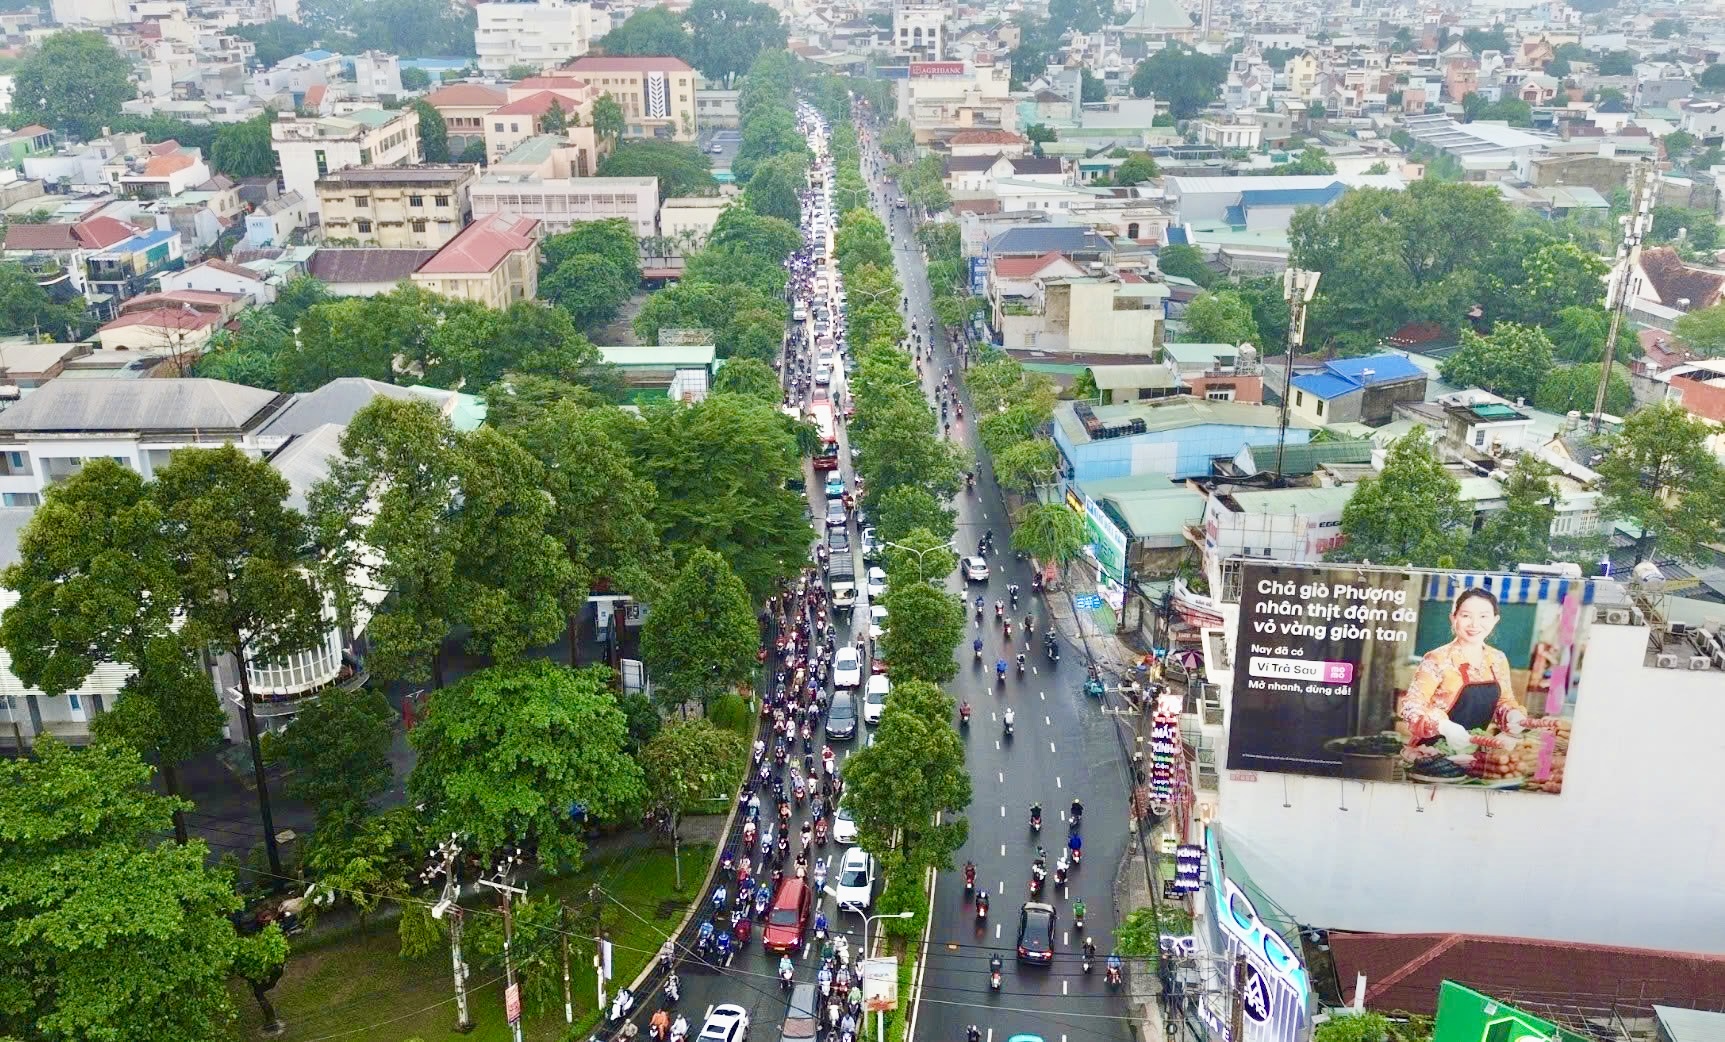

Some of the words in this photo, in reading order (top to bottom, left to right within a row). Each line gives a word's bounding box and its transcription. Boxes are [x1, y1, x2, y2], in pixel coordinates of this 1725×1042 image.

[1257, 579, 1296, 597] Chả
[1299, 582, 1330, 600] giò
[1333, 584, 1407, 605] Phượng
[1255, 600, 1303, 616] nhân
[1307, 602, 1341, 621] thịt
[1344, 605, 1388, 623] đậm
[1391, 607, 1417, 623] đà
[1253, 619, 1277, 634] vỏ
[1280, 620, 1327, 640] vàng
[1330, 623, 1372, 641] giòn
[1375, 627, 1408, 642] tan
[1251, 644, 1272, 656] Nay
[1274, 645, 1289, 656] đã
[1290, 647, 1304, 657] có
[1257, 662, 1269, 672] Ví
[1272, 663, 1291, 673] Trả
[1293, 665, 1317, 675] Sau
[1248, 679, 1266, 690] Mở
[1267, 682, 1304, 694] nhanh,
[1305, 684, 1332, 696] dùng
